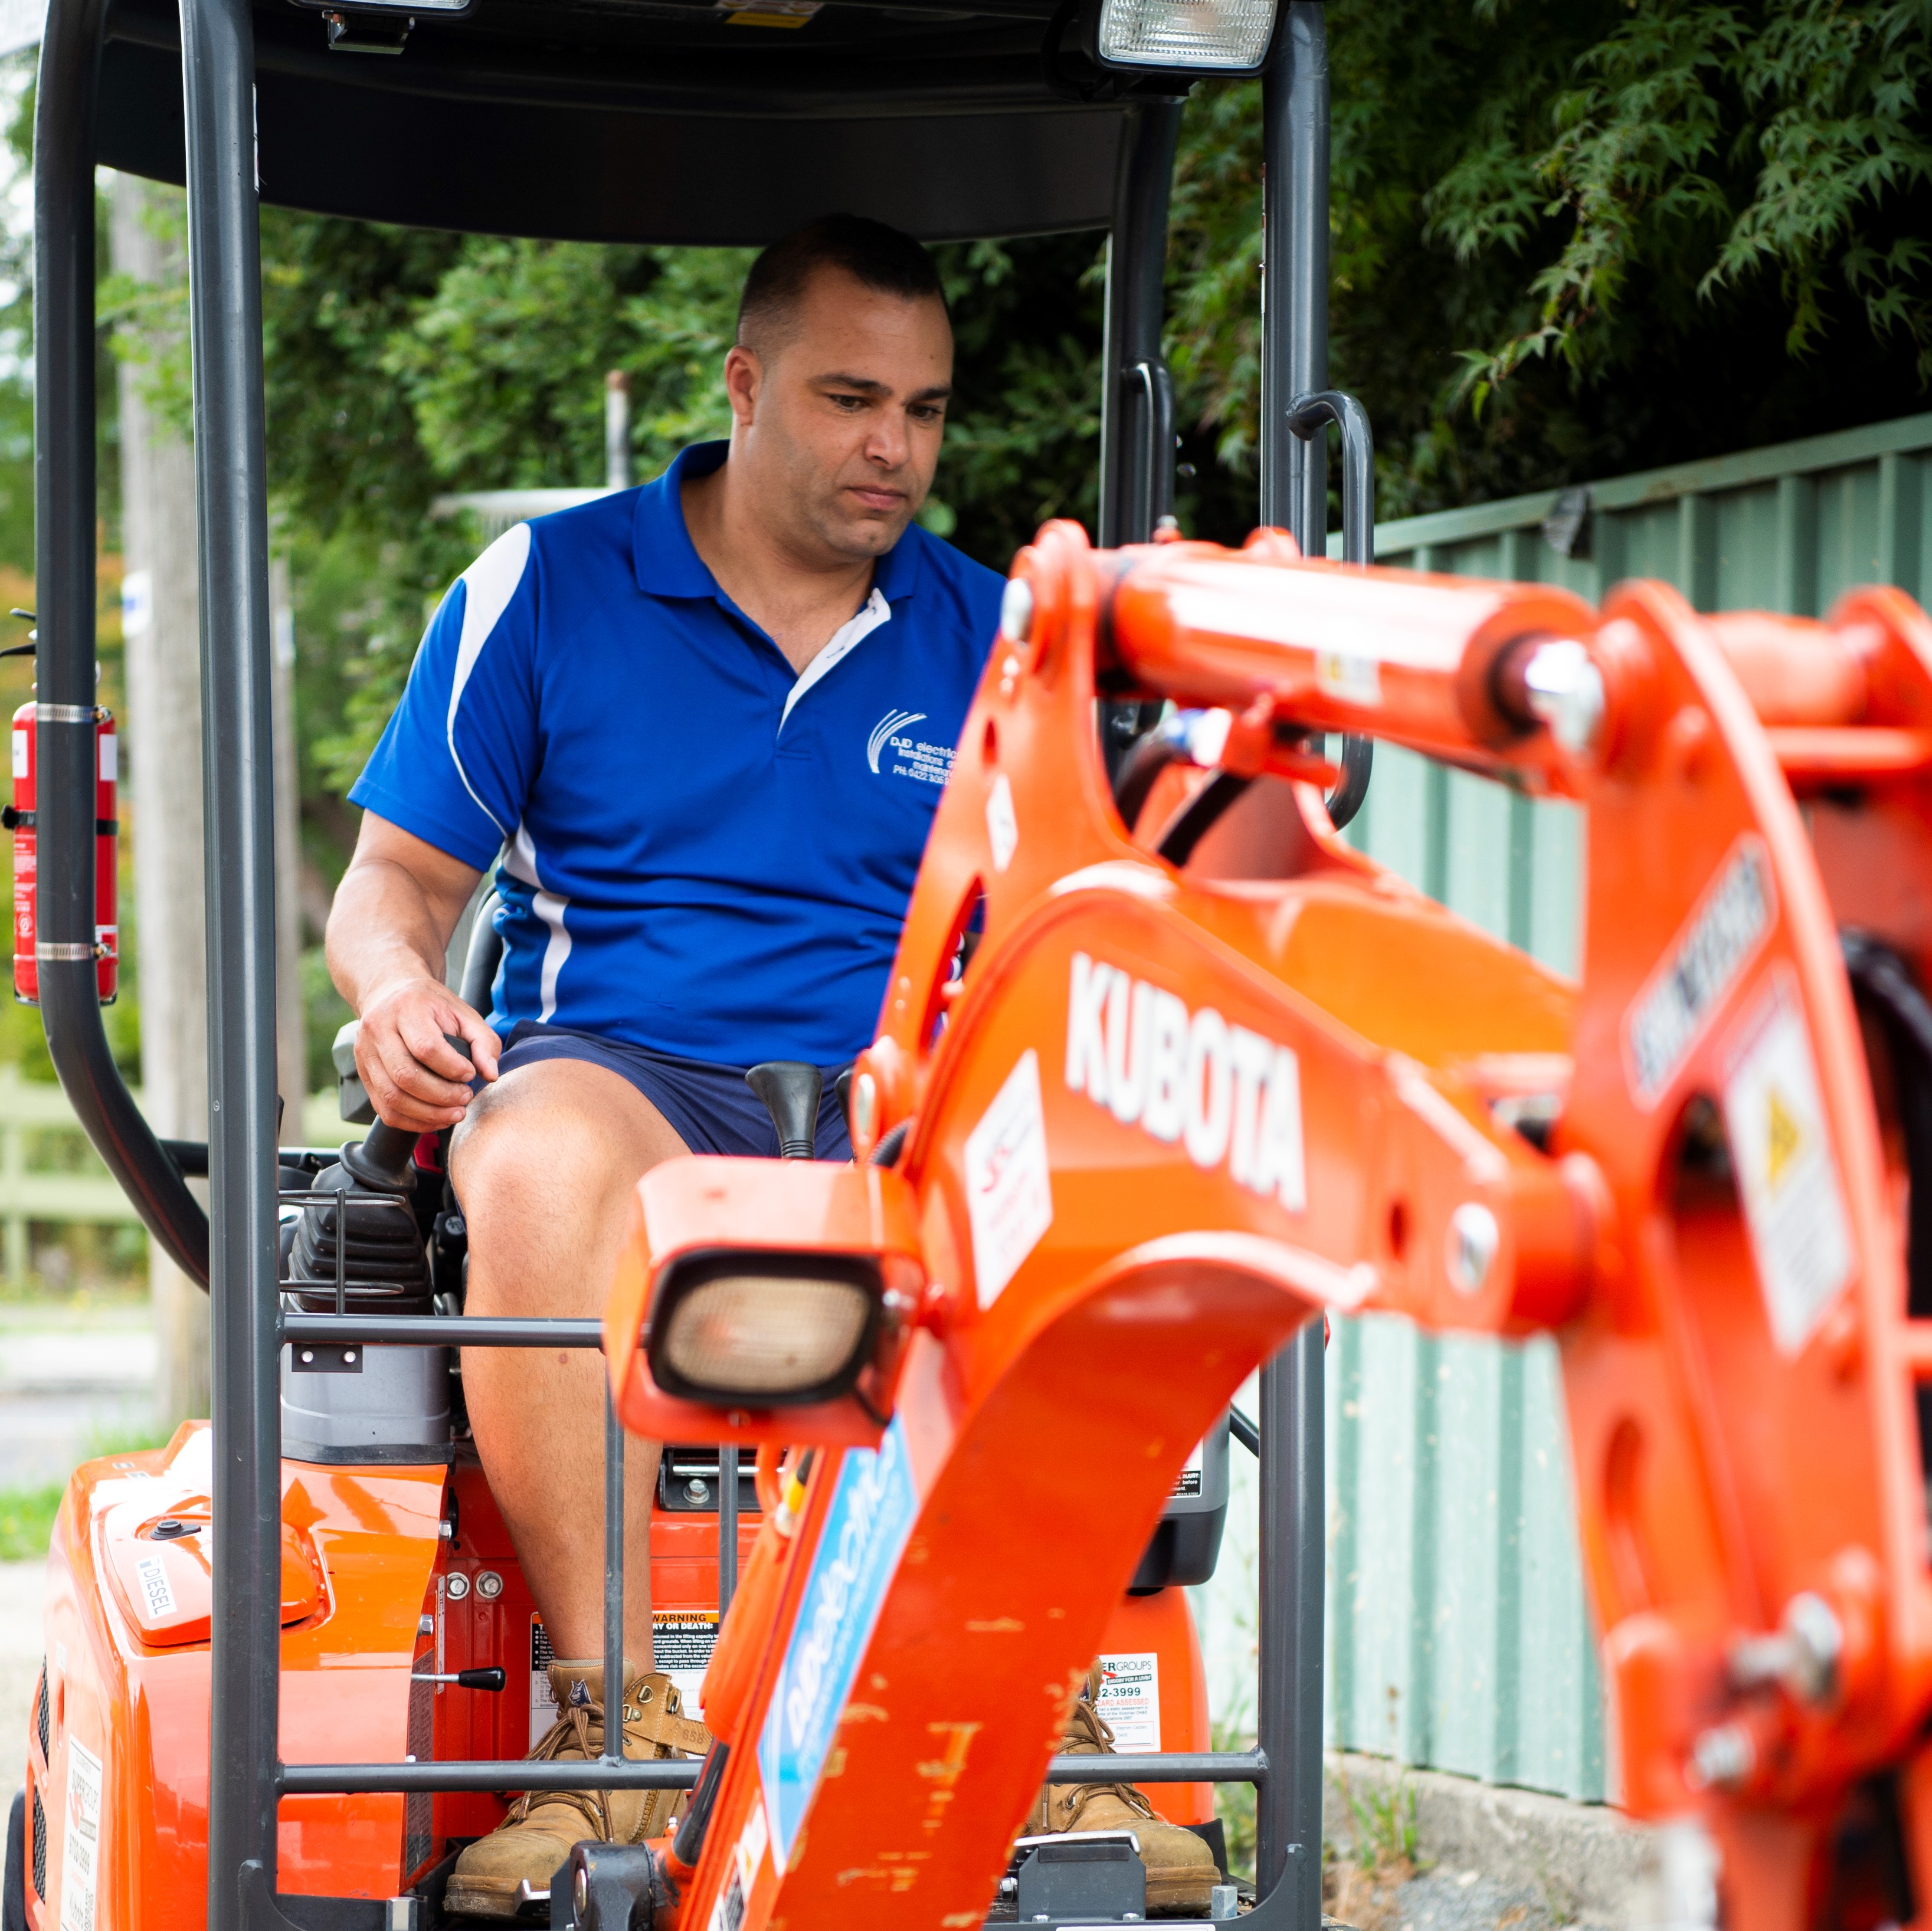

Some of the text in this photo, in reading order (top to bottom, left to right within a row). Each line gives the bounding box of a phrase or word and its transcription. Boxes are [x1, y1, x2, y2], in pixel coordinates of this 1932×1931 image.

[890, 736, 913, 748] DJD
[1065, 950, 1306, 1213] KUBOTA
[143, 1568, 170, 1615] DIESEL
